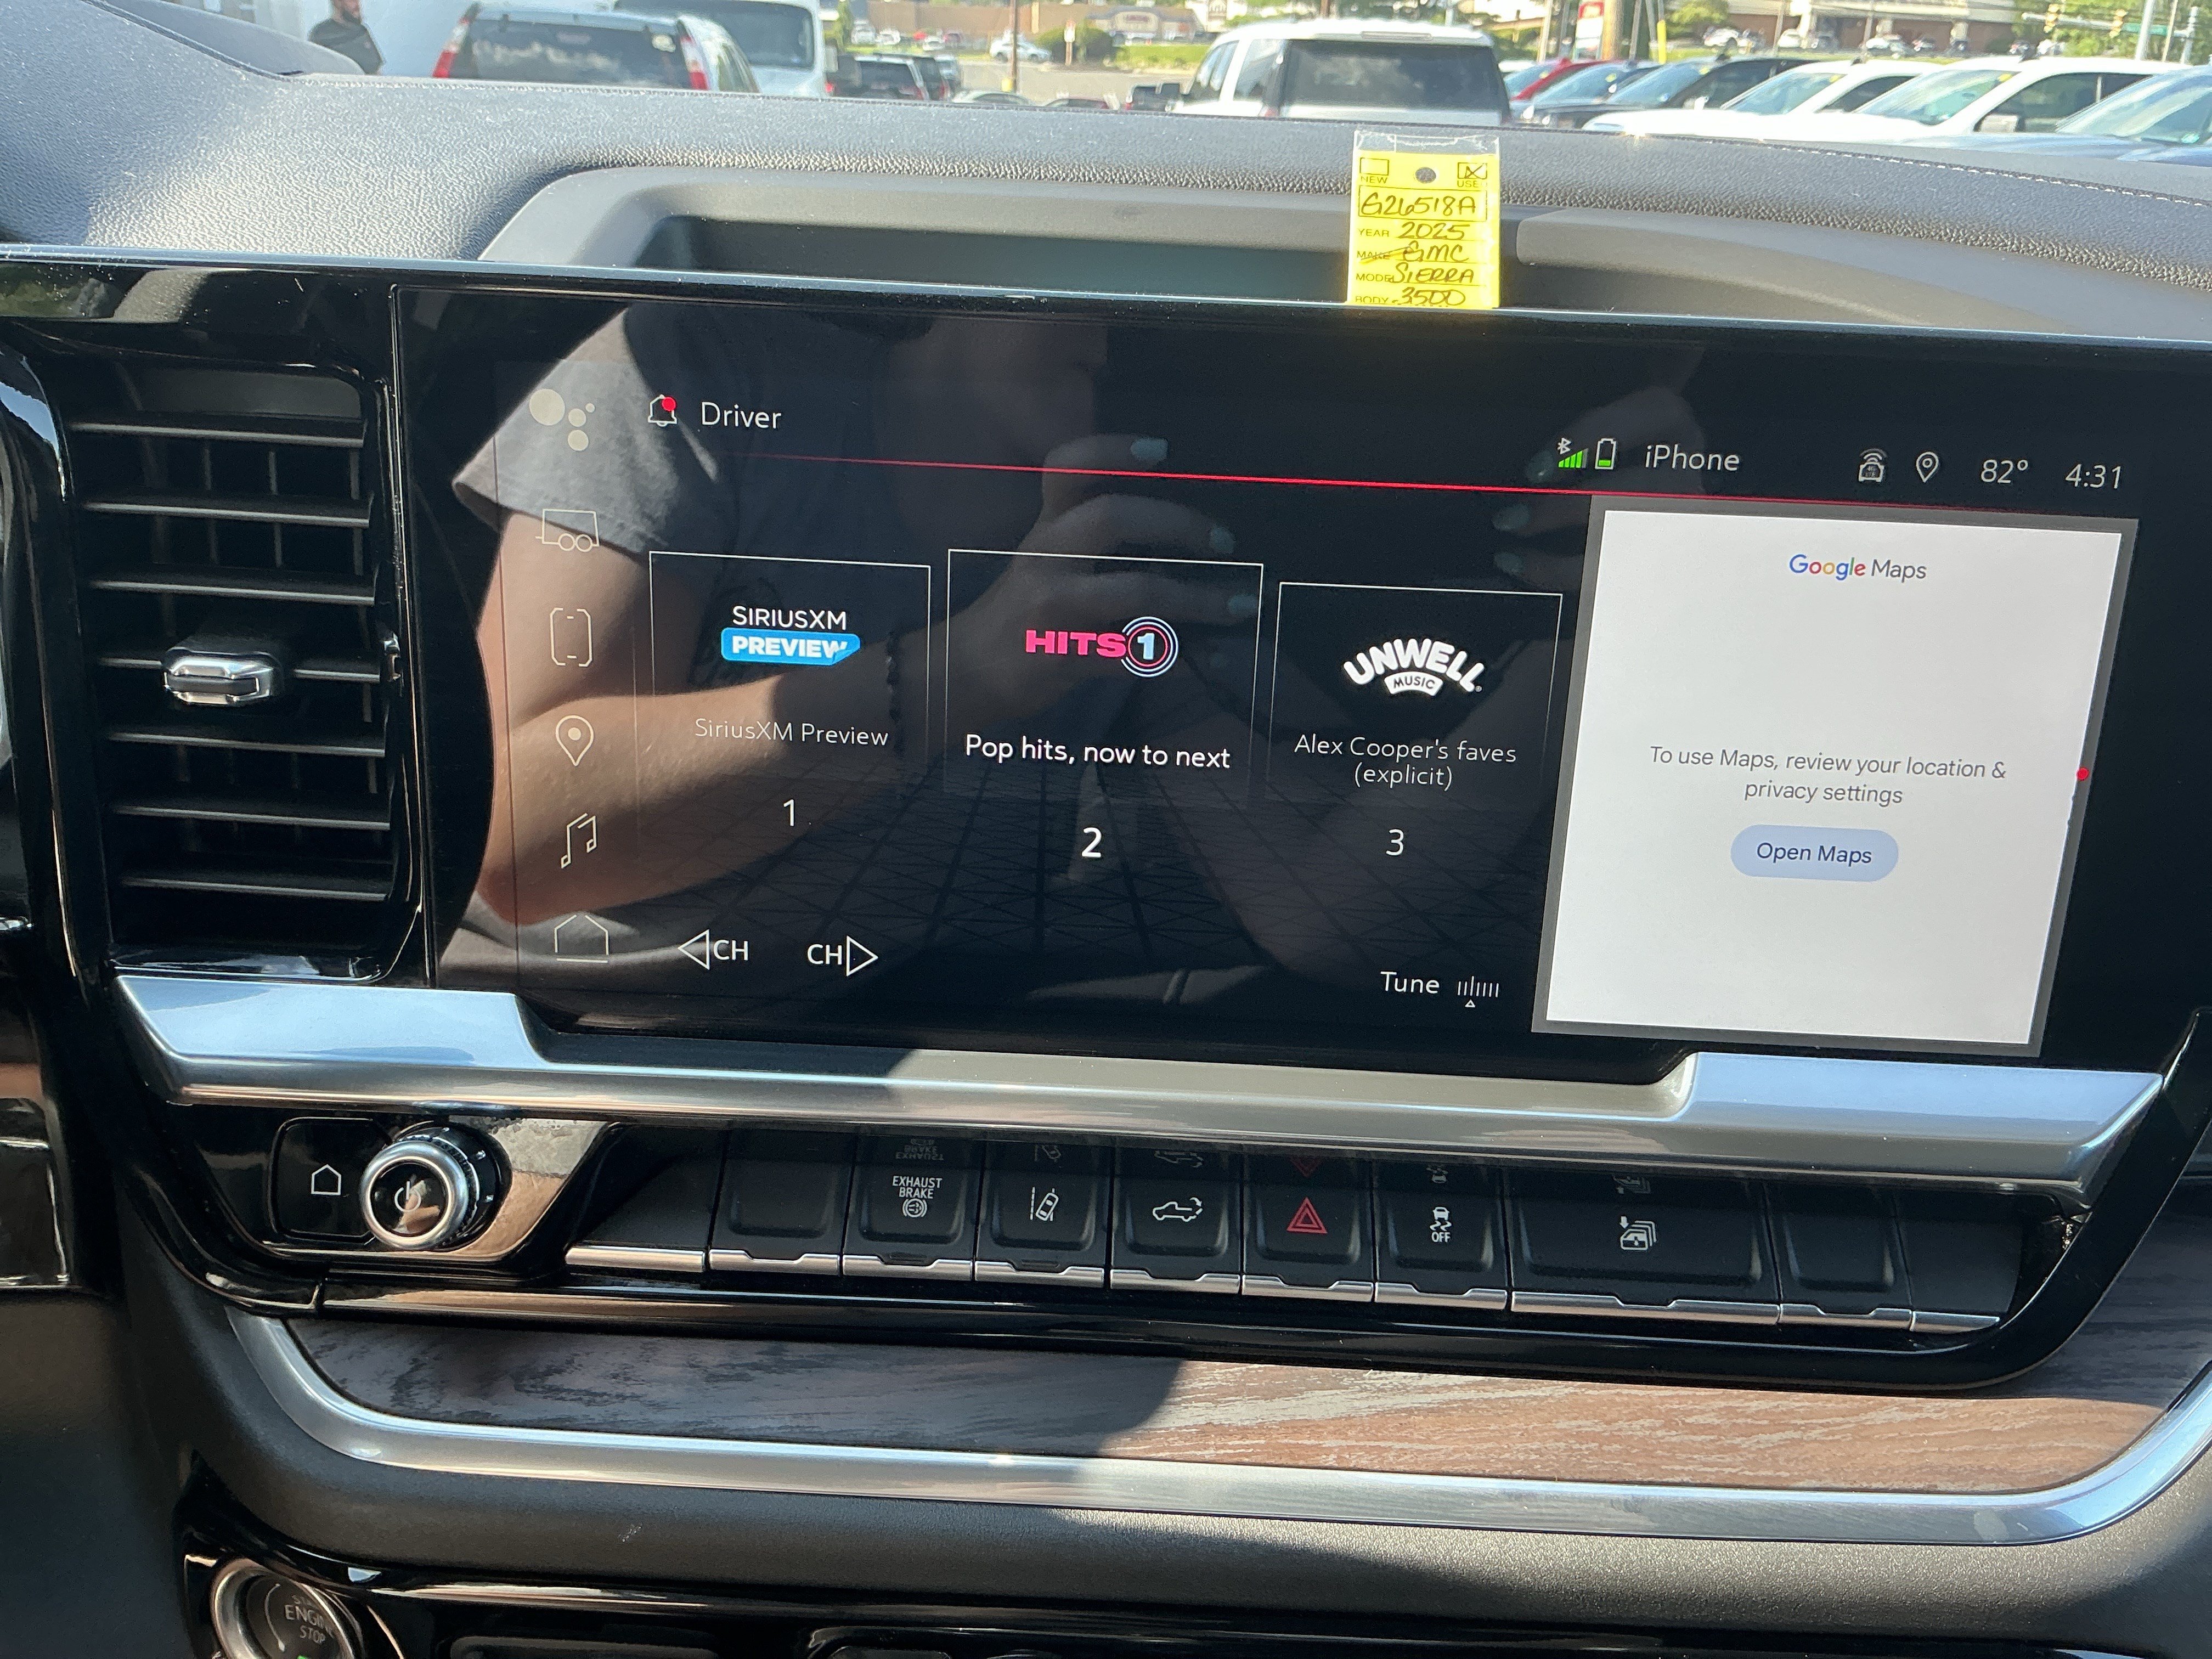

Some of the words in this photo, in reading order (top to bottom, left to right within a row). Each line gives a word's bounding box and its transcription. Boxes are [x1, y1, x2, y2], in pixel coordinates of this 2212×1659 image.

[1361, 192, 1476, 216] G26518A
[1358, 229, 1390, 237] YEAR
[1398, 222, 1470, 240] 2025
[1402, 240, 1469, 262] GMC
[1392, 262, 1474, 283] SIERRA
[702, 402, 782, 428] Driver
[1645, 444, 1740, 471] iPhone
[2066, 464, 2122, 489] 4:31
[1789, 554, 1866, 580] Google
[1871, 559, 1927, 583] Maps
[732, 605, 847, 630] SIRIUSXM
[732, 635, 848, 659] PREVIEW
[1025, 630, 1126, 658] HITS
[1344, 638, 1485, 692] UNWELL
[1392, 676, 1436, 690] MUSIC
[695, 718, 793, 742] SiriusXM
[802, 723, 889, 746] Preview
[966, 734, 1013, 763] Pop
[1022, 735, 1075, 764] hits,
[1084, 746, 1135, 764] now
[1142, 745, 1167, 766] to
[1176, 748, 1231, 769] next
[1294, 733, 1342, 755] Alex
[1350, 737, 1448, 763] Cooper's
[1457, 740, 1517, 763] faves
[1650, 746, 1672, 763] To
[1678, 751, 1713, 765] use
[1719, 749, 1779, 771] Maps,
[1785, 752, 1851, 771] review
[1855, 757, 1901, 776] your
[1906, 757, 1986, 778] location
[1991, 761, 2006, 778] &
[1355, 761, 1453, 792] (explicit)
[1744, 780, 1818, 803] privacy
[1823, 785, 1903, 807] settings
[783, 799, 795, 827] 1
[1081, 827, 1102, 858] 2
[1386, 828, 1404, 856] 3
[1757, 842, 1811, 863] Open
[1818, 845, 1872, 867] Maps
[713, 939, 748, 961] CH
[807, 944, 842, 965] CH
[1380, 971, 1440, 994] Tune
[892, 1175, 943, 1189] EXHAUST
[899, 1187, 934, 1199] BRAKE
[1431, 1232, 1451, 1243] OFF
[300, 1624, 326, 1644] STOP
